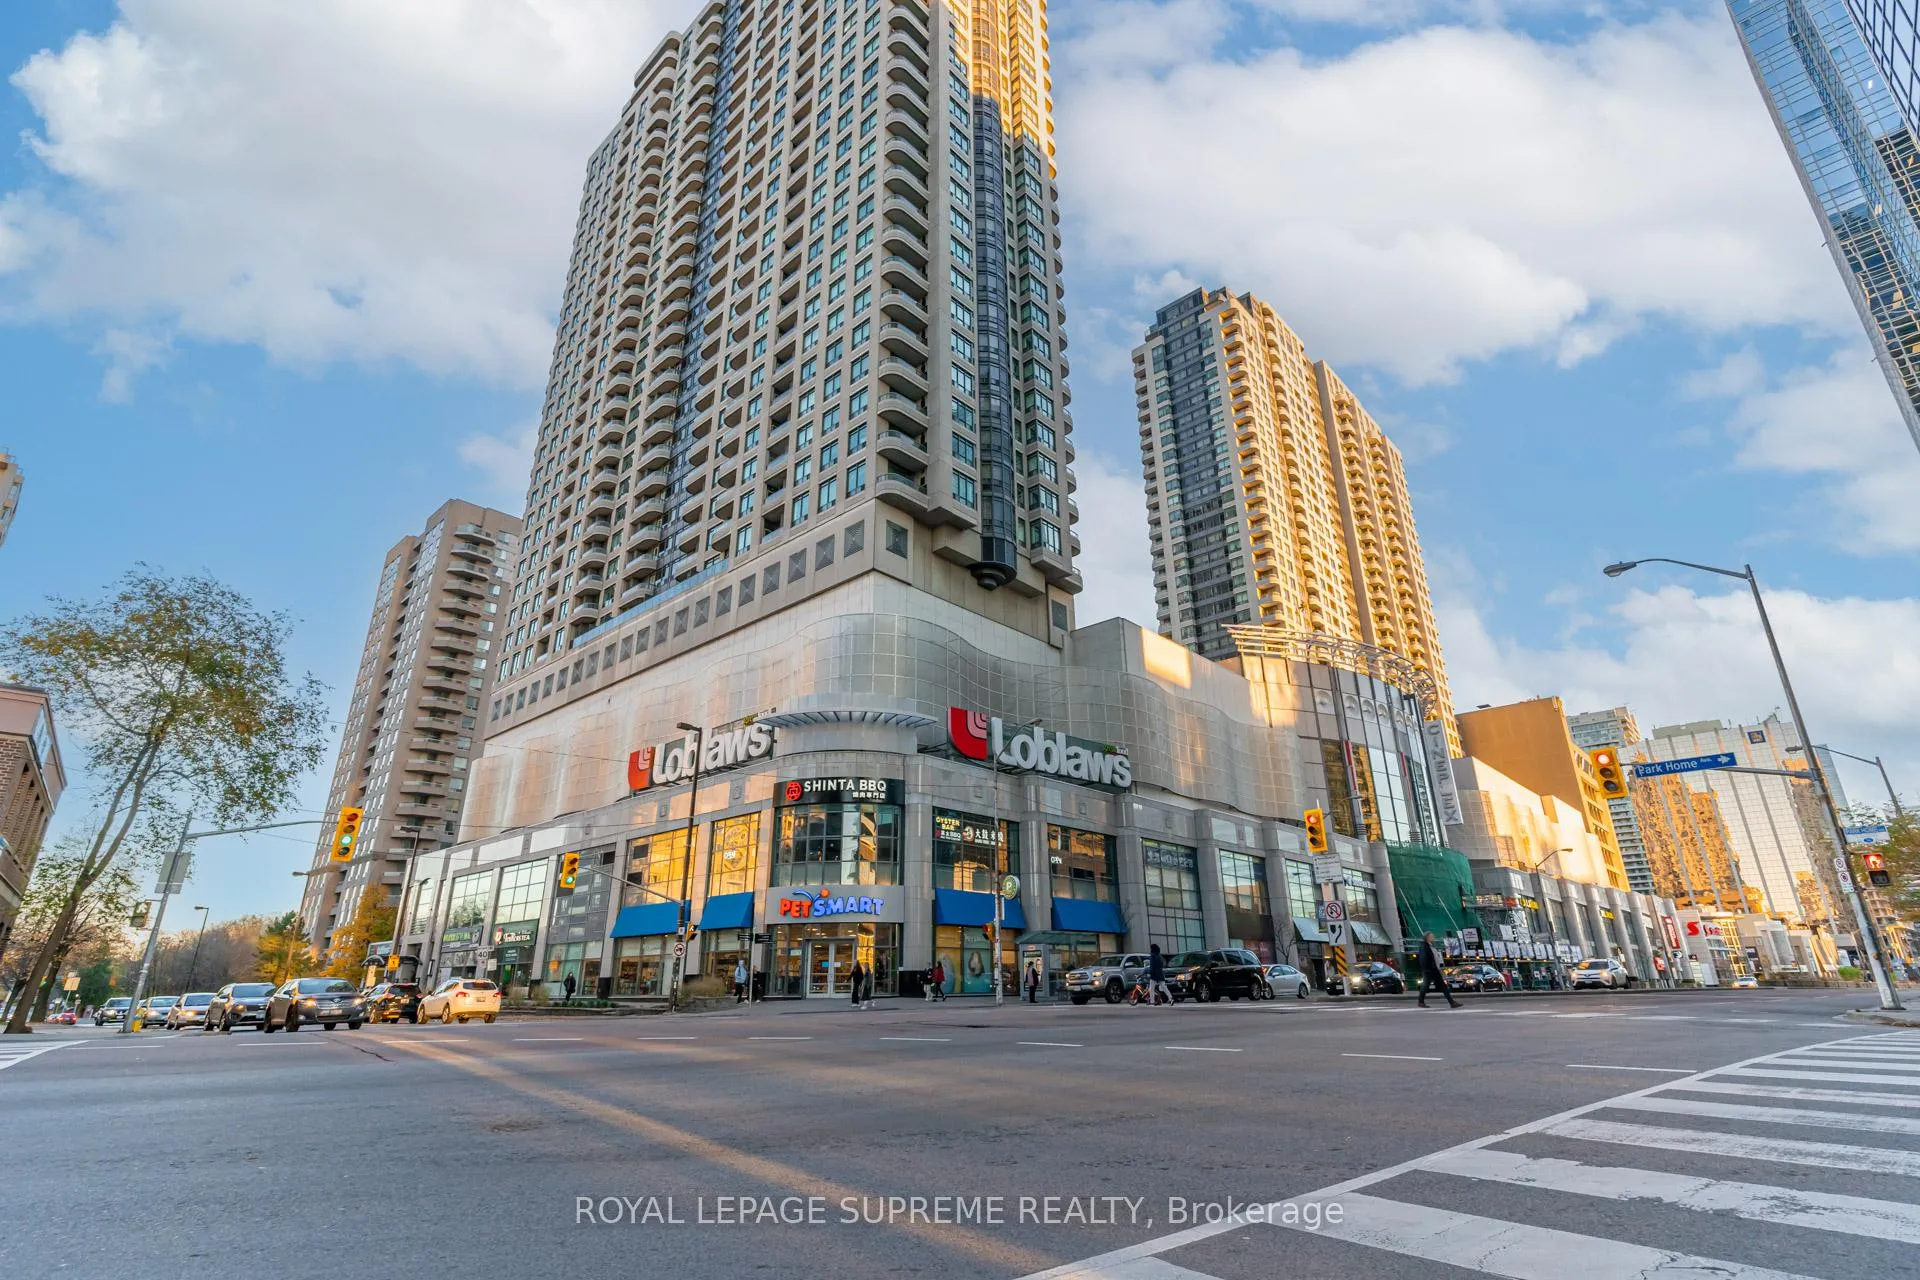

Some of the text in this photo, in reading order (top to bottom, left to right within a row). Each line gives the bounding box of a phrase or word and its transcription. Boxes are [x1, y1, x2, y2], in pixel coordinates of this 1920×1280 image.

[653, 723, 772, 784] Loblaws
[991, 717, 1132, 788] Loblaws
[1637, 764, 1663, 777] Park
[1665, 760, 1698, 773] Home
[803, 779, 855, 792] SHINTA
[859, 779, 887, 792] BBQ
[935, 816, 960, 826] OYSTER
[941, 823, 955, 831] BAR
[478, 950, 488, 958] 40
